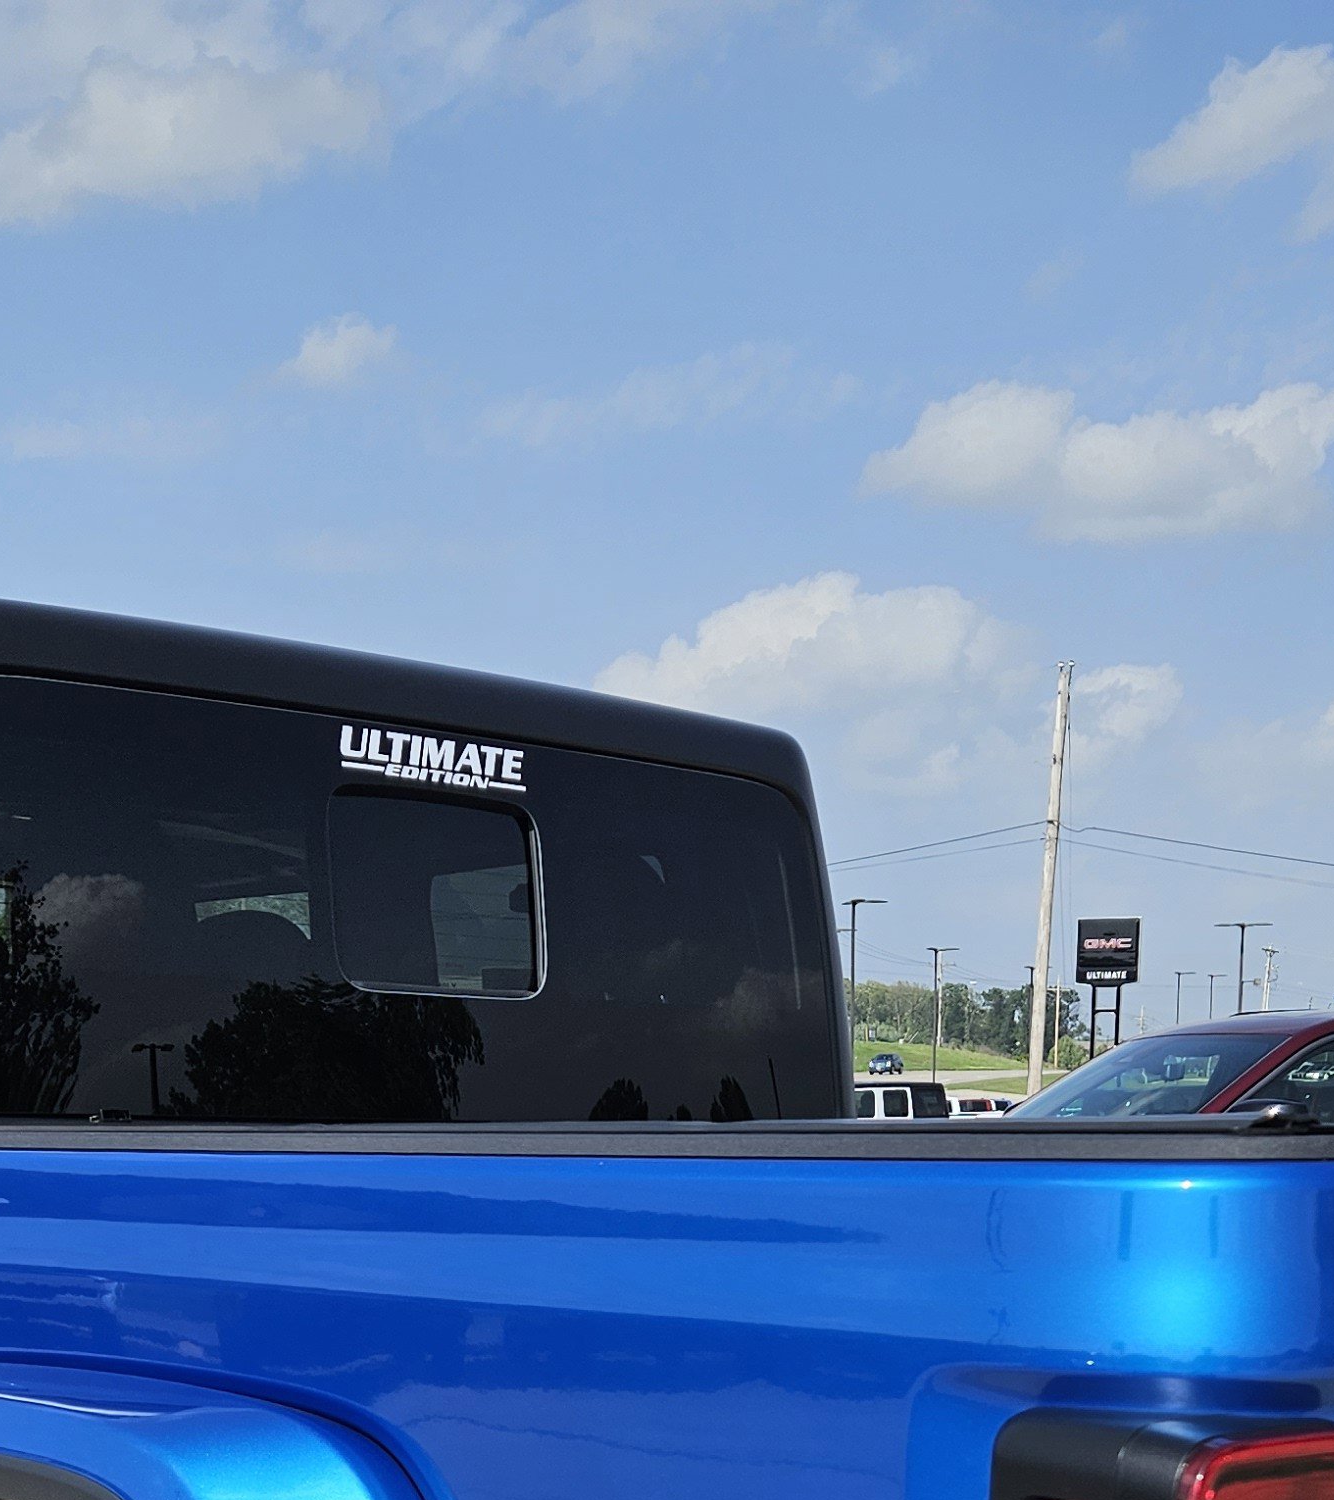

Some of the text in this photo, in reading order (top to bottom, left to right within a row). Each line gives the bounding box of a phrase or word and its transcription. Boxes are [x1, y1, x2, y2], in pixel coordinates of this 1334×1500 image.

[339, 724, 525, 781] ULTIMATE
[384, 763, 491, 789] EDITION
[1083, 937, 1133, 950] GMC
[1086, 970, 1128, 980] ULTIMATE
